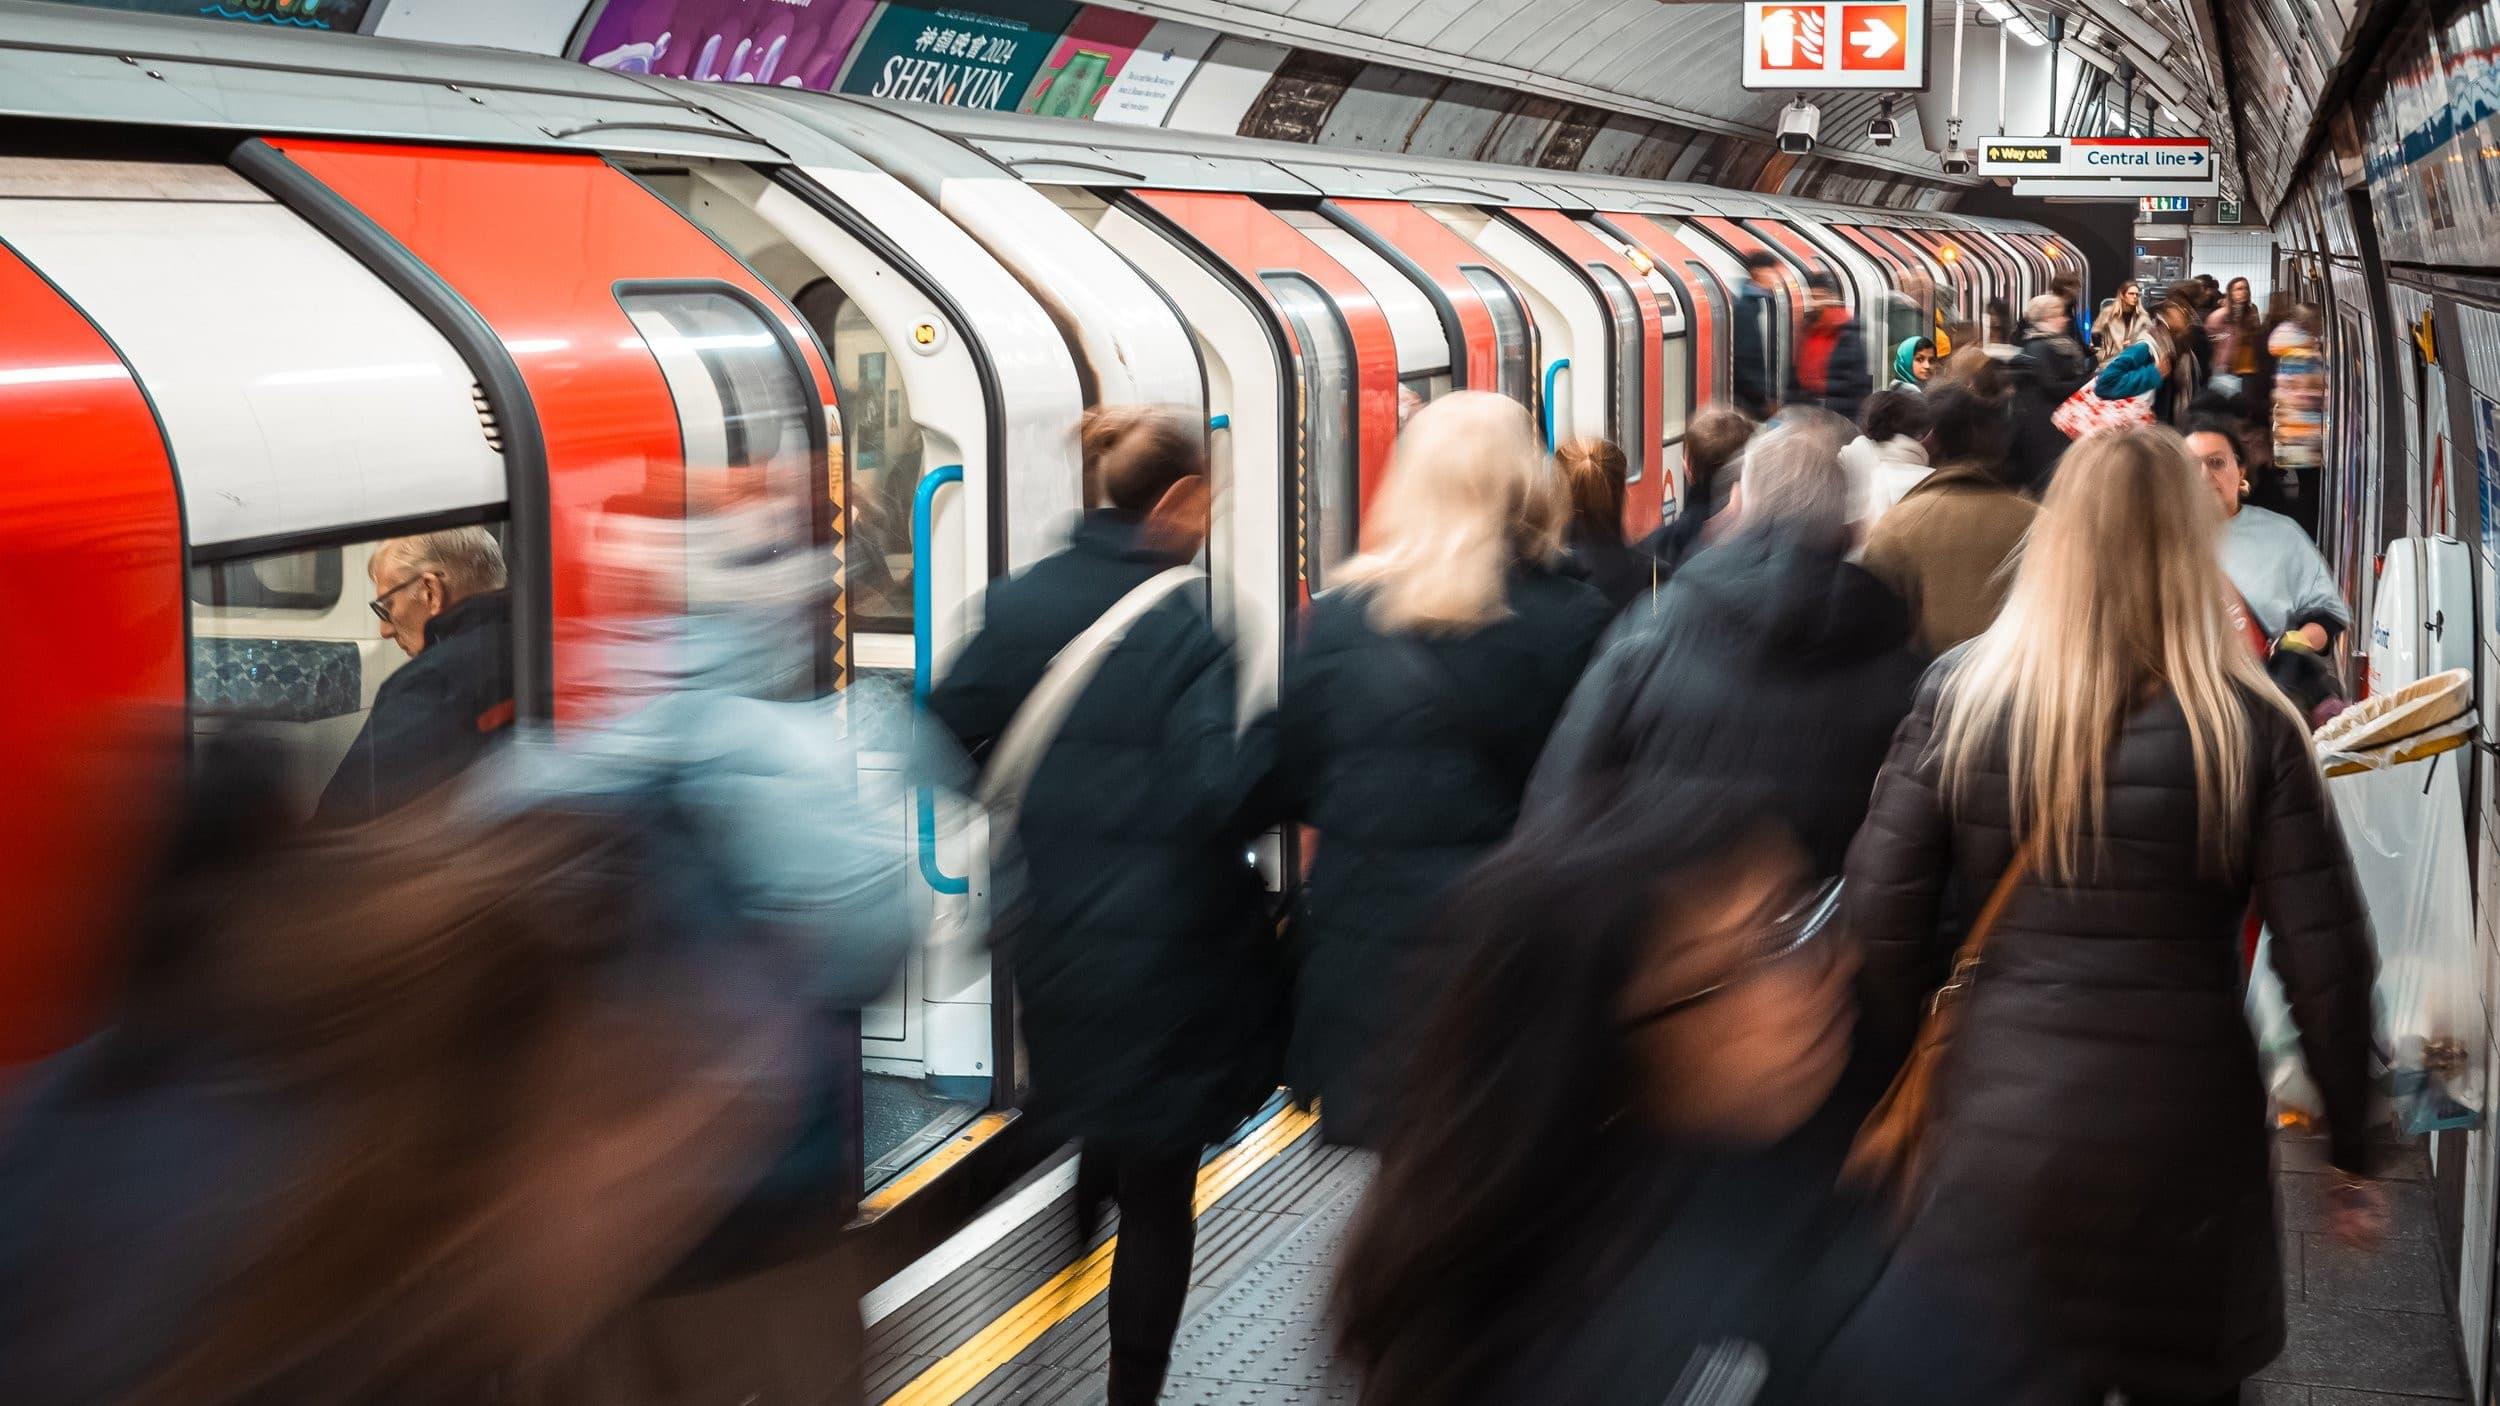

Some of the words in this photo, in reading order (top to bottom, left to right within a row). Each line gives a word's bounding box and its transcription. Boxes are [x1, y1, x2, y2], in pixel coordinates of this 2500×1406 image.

[979, 37, 1018, 65] 2024
[872, 55, 960, 104] SHEN
[952, 66, 1014, 110] YUN
[2001, 147, 2026, 162] Way
[2027, 148, 2048, 160] out
[2087, 151, 2149, 165] Central
[2156, 151, 2186, 165] line
